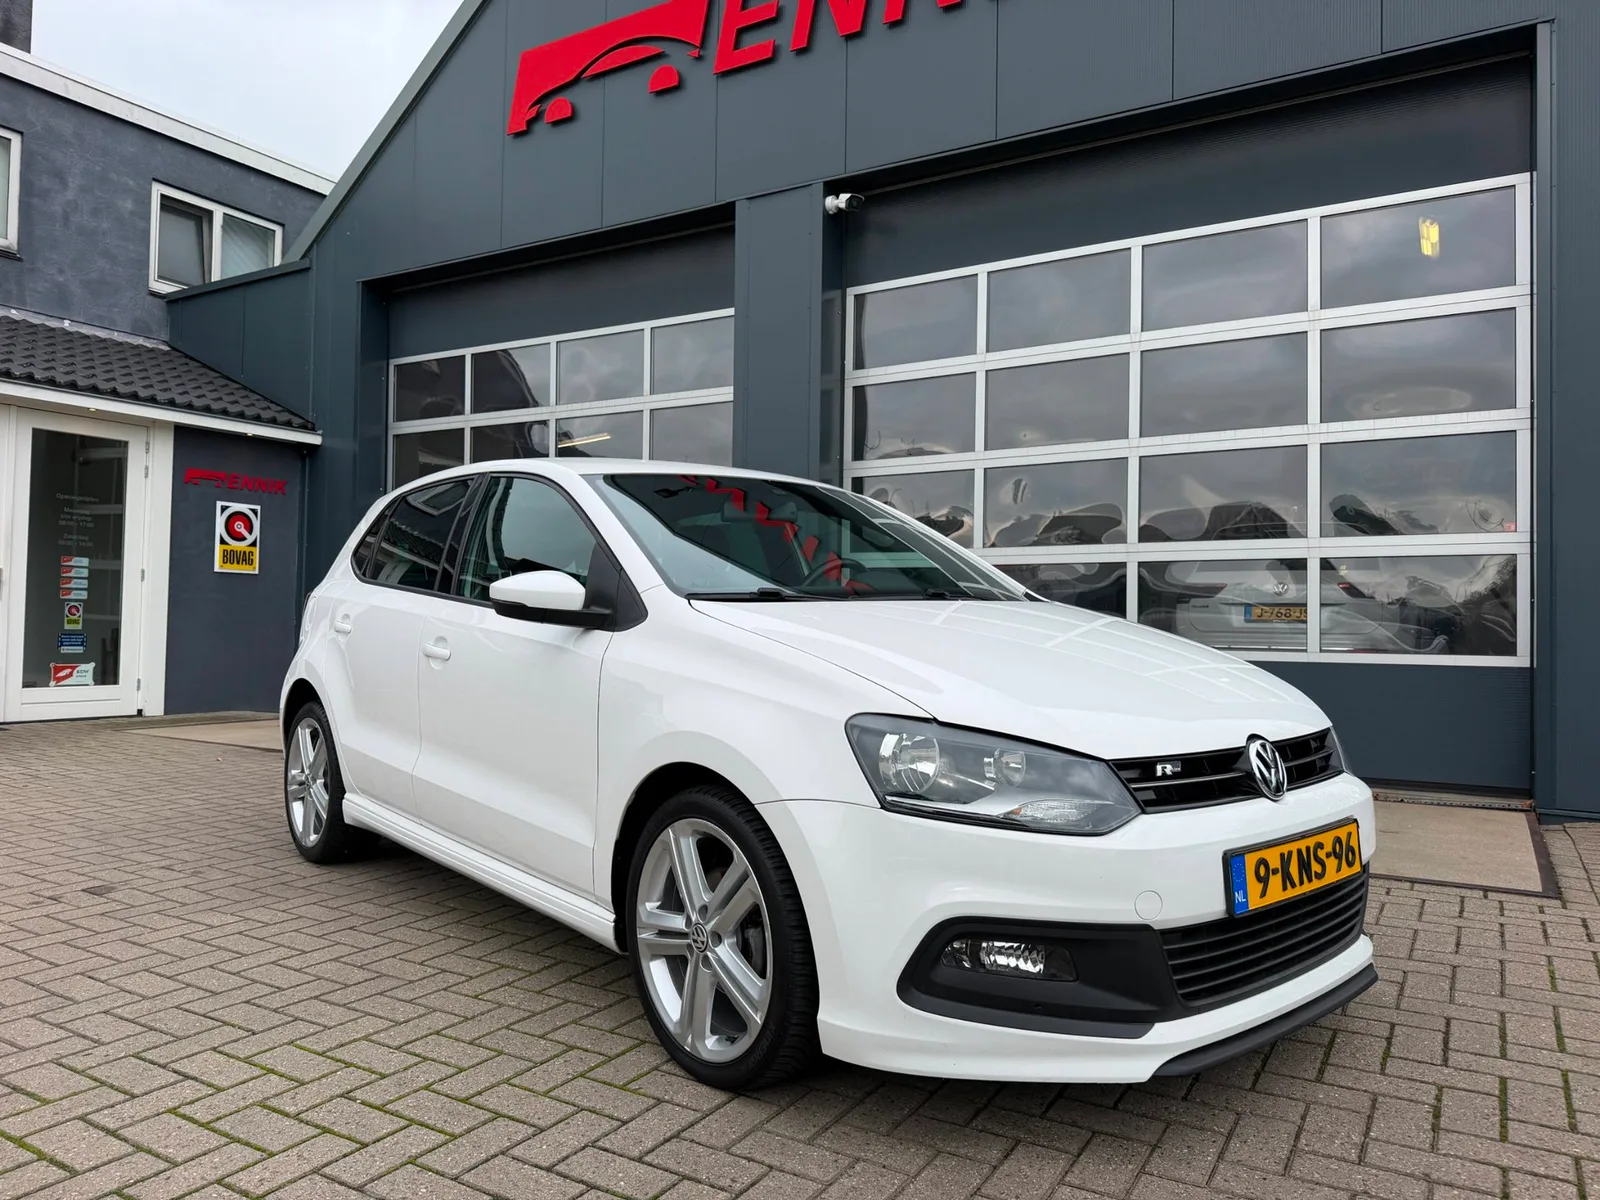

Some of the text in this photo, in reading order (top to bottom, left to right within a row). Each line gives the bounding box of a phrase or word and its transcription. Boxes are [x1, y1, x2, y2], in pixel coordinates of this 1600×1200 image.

[226, 473, 288, 495] ENNIK
[222, 549, 254, 566] BOVAG
[1254, 831, 1356, 899] 9-KNS-96
[1234, 889, 1247, 904] NL
